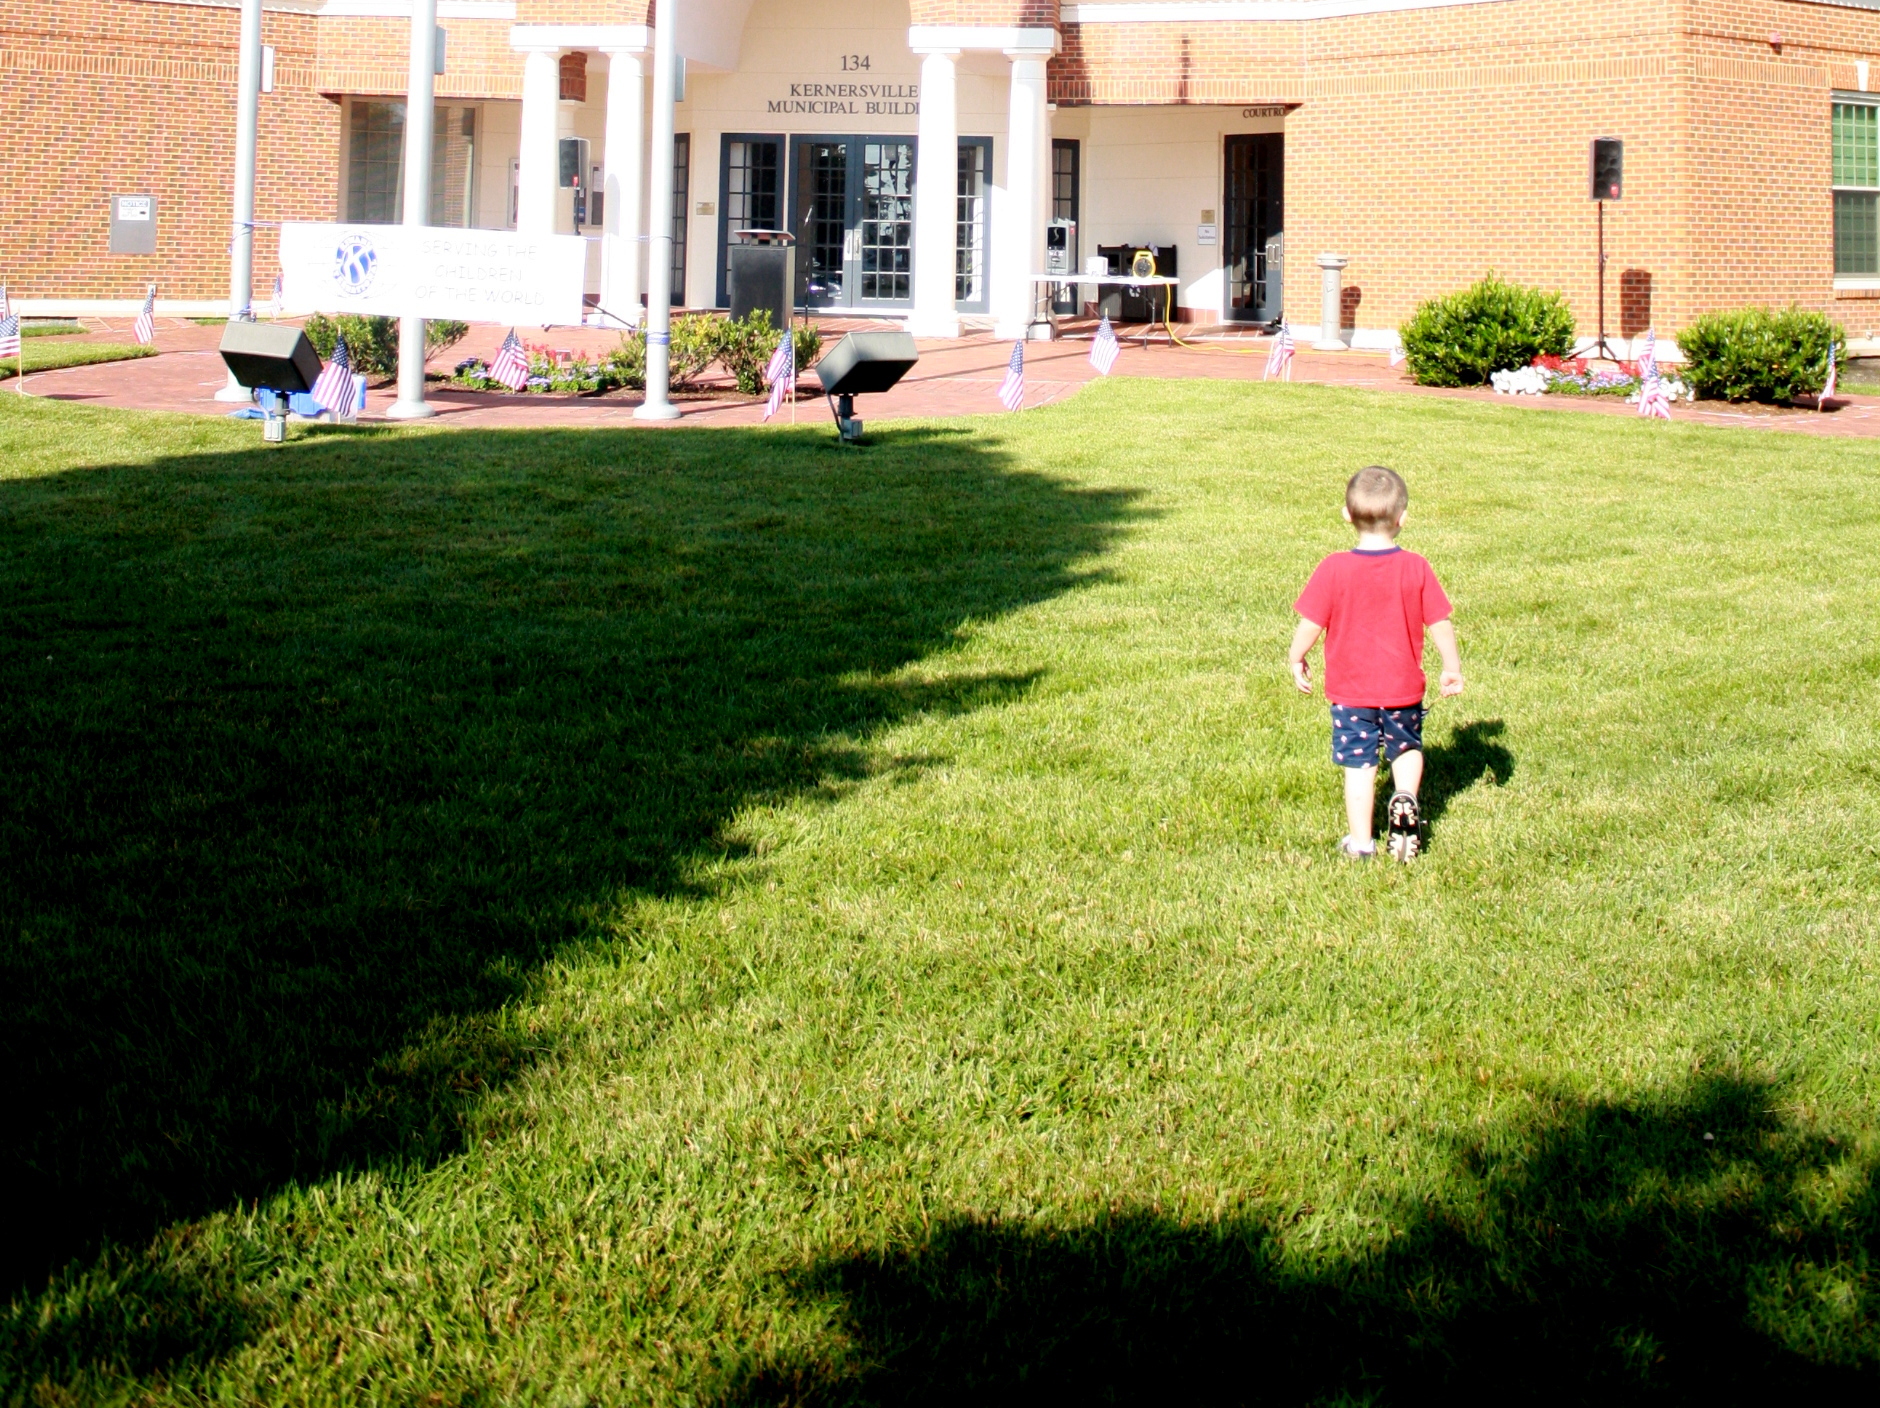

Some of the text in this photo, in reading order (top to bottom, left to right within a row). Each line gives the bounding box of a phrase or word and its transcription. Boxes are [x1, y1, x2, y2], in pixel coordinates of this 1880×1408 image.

[841, 55, 870, 71] 134
[790, 83, 918, 98] KERNERSVILLE
[767, 100, 920, 115] MUNICIPAL BUILDI
[1242, 107, 1285, 118] COURTRO
[422, 239, 538, 260] SERVING THE
[434, 264, 522, 282] CHILDREN
[415, 285, 545, 306] OF THE WORLD
